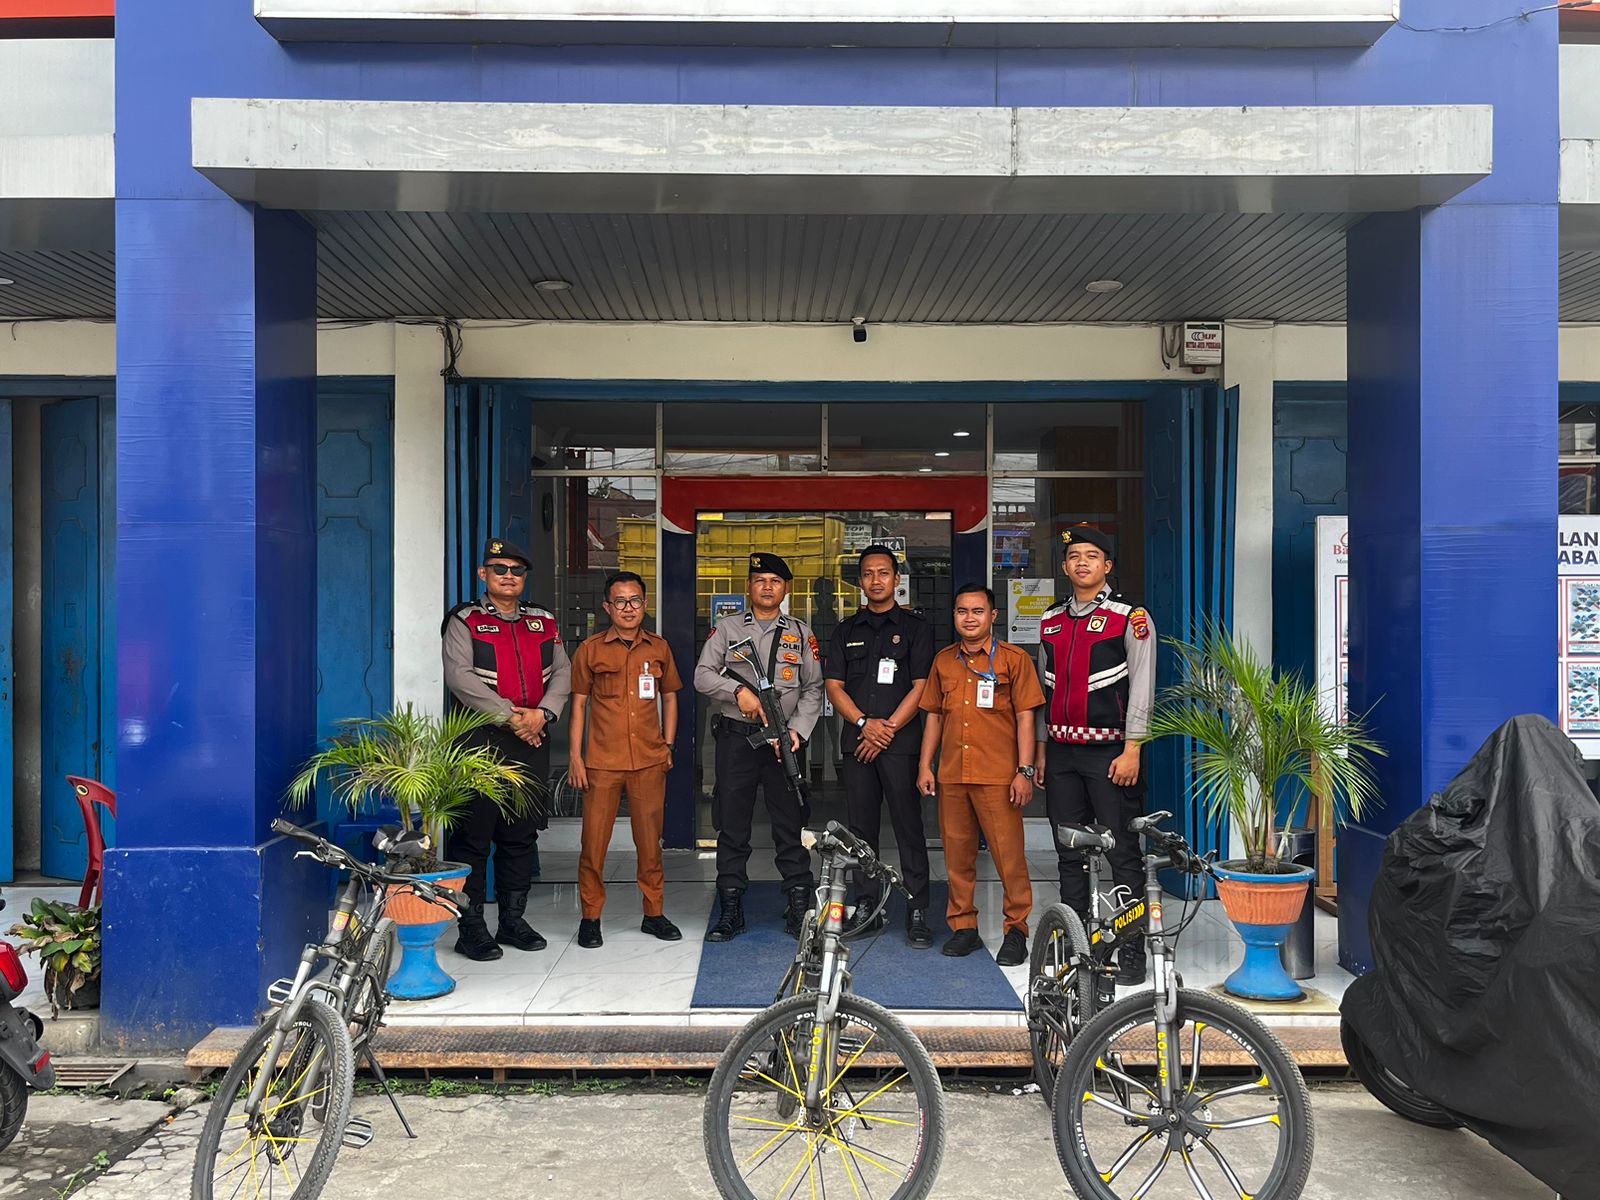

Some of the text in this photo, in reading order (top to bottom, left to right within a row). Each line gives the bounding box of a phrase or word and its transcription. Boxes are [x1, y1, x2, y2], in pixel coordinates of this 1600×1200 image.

[1559, 531, 1599, 547] LAN
[1558, 550, 1600, 565] ABA
[779, 642, 800, 651] OLRI
[1114, 908, 1135, 932] POLISI
[835, 1012, 878, 1031] PATROLI
[1108, 1020, 1138, 1043] PATROLI
[1225, 1028, 1256, 1054] POLISI
[809, 1028, 821, 1081] POLISI
[1157, 1031, 1168, 1087] POLISI
[1075, 1122, 1089, 1157] POLISI
